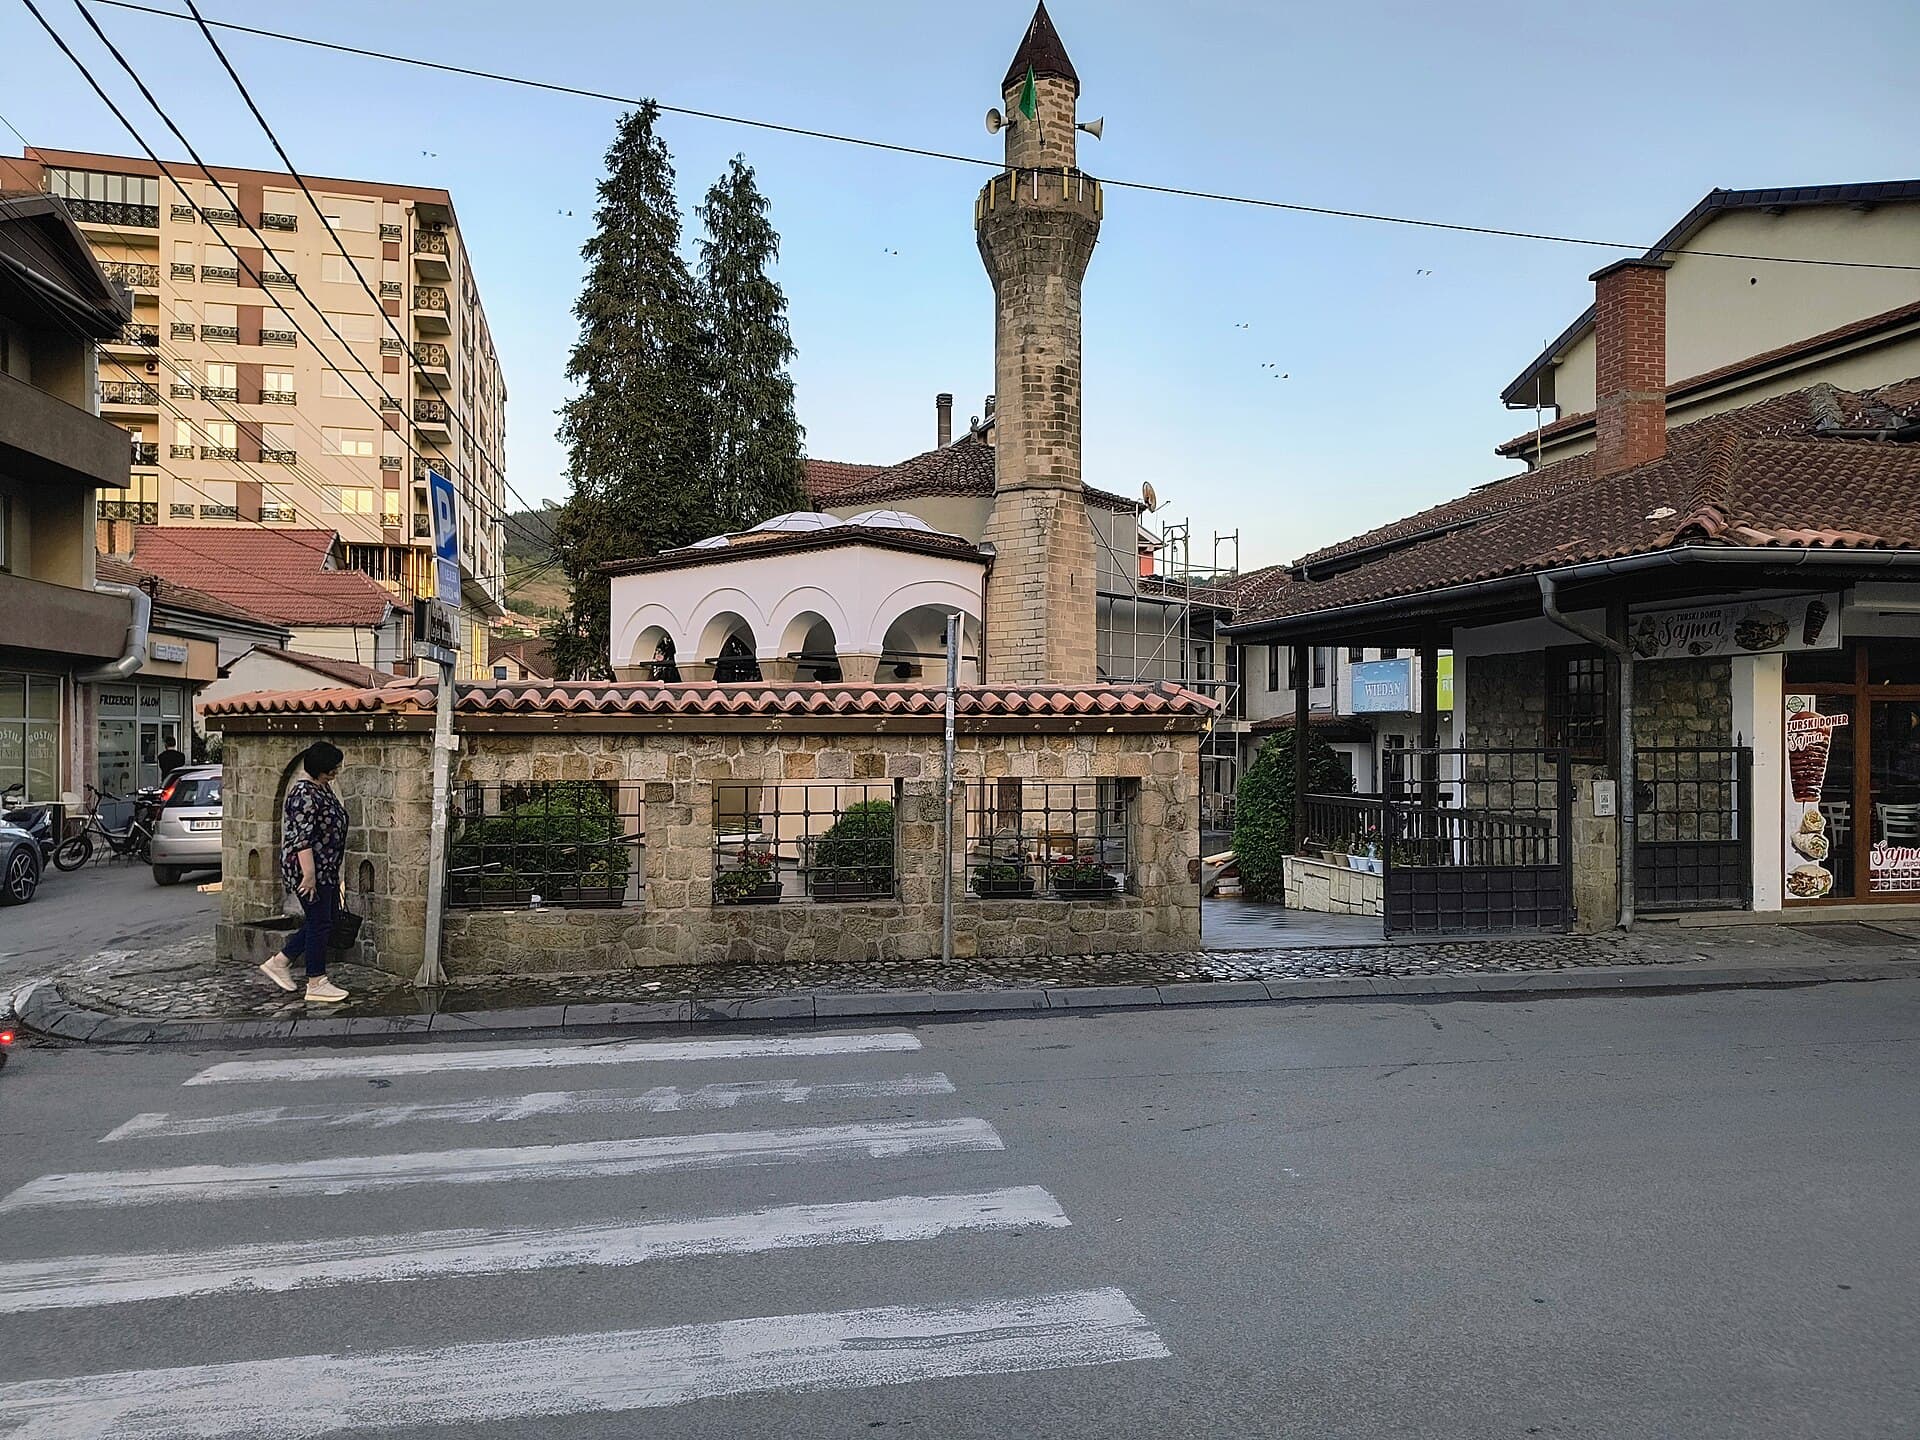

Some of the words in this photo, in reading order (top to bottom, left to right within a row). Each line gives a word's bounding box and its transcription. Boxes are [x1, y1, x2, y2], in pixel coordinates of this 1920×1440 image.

[435, 485, 451, 548] P
[1676, 611, 1700, 622] TURSKI
[1700, 609, 1722, 620] DONER
[1658, 616, 1724, 649] Sajma
[1787, 717, 1819, 732] TURSKI
[1819, 715, 1848, 727] DONER
[0, 728, 23, 744] OŠTILJ
